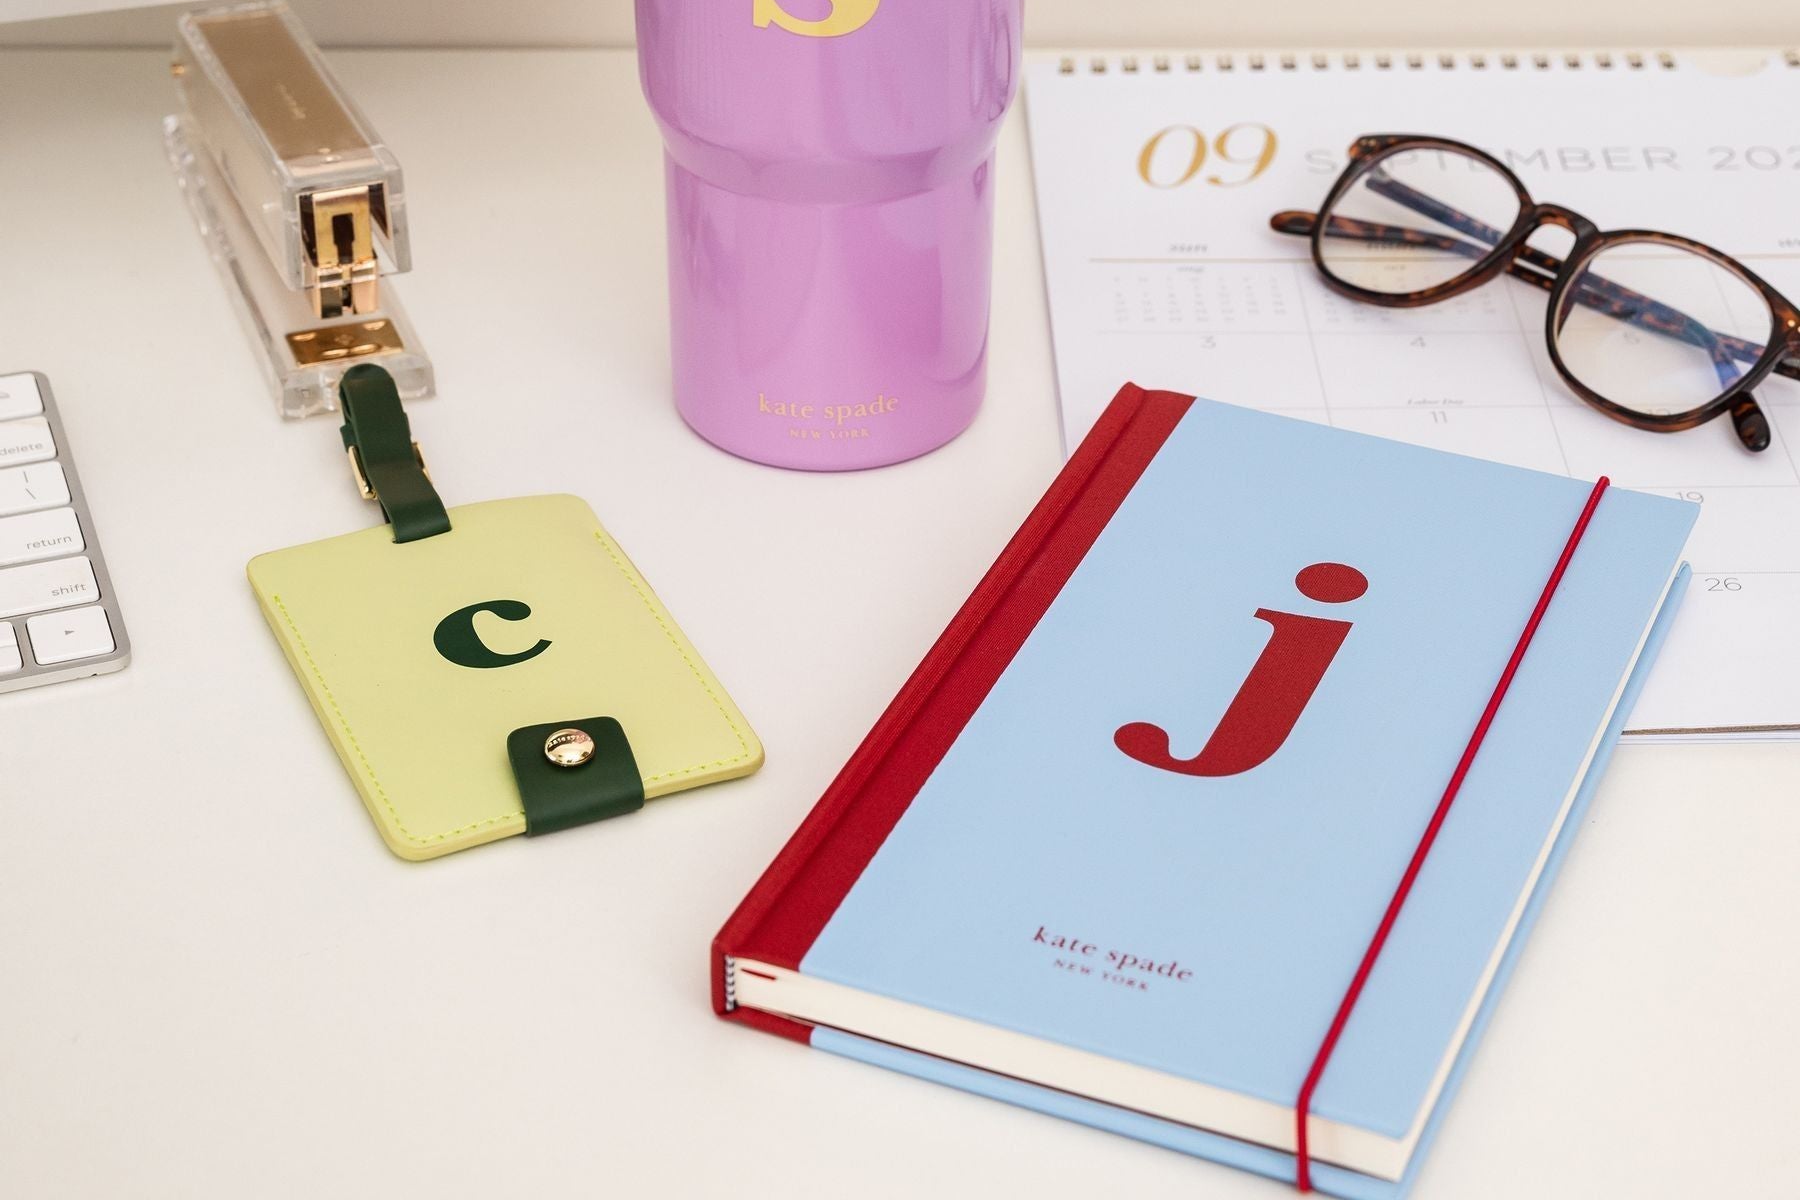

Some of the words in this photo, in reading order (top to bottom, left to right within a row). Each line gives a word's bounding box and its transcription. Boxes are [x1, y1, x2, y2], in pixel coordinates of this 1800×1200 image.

[1136, 121, 1279, 190] 09
[758, 392, 815, 419] kate
[823, 393, 899, 426] spade
[1428, 409, 1448, 424] 11
[789, 428, 821, 440] NEW
[829, 427, 870, 440] YORK
[26, 535, 73, 550] return
[51, 583, 87, 597] shift
[1704, 577, 1742, 592] 26
[1113, 562, 1369, 778] j
[1033, 925, 1098, 954] kate
[1107, 949, 1193, 981] spade
